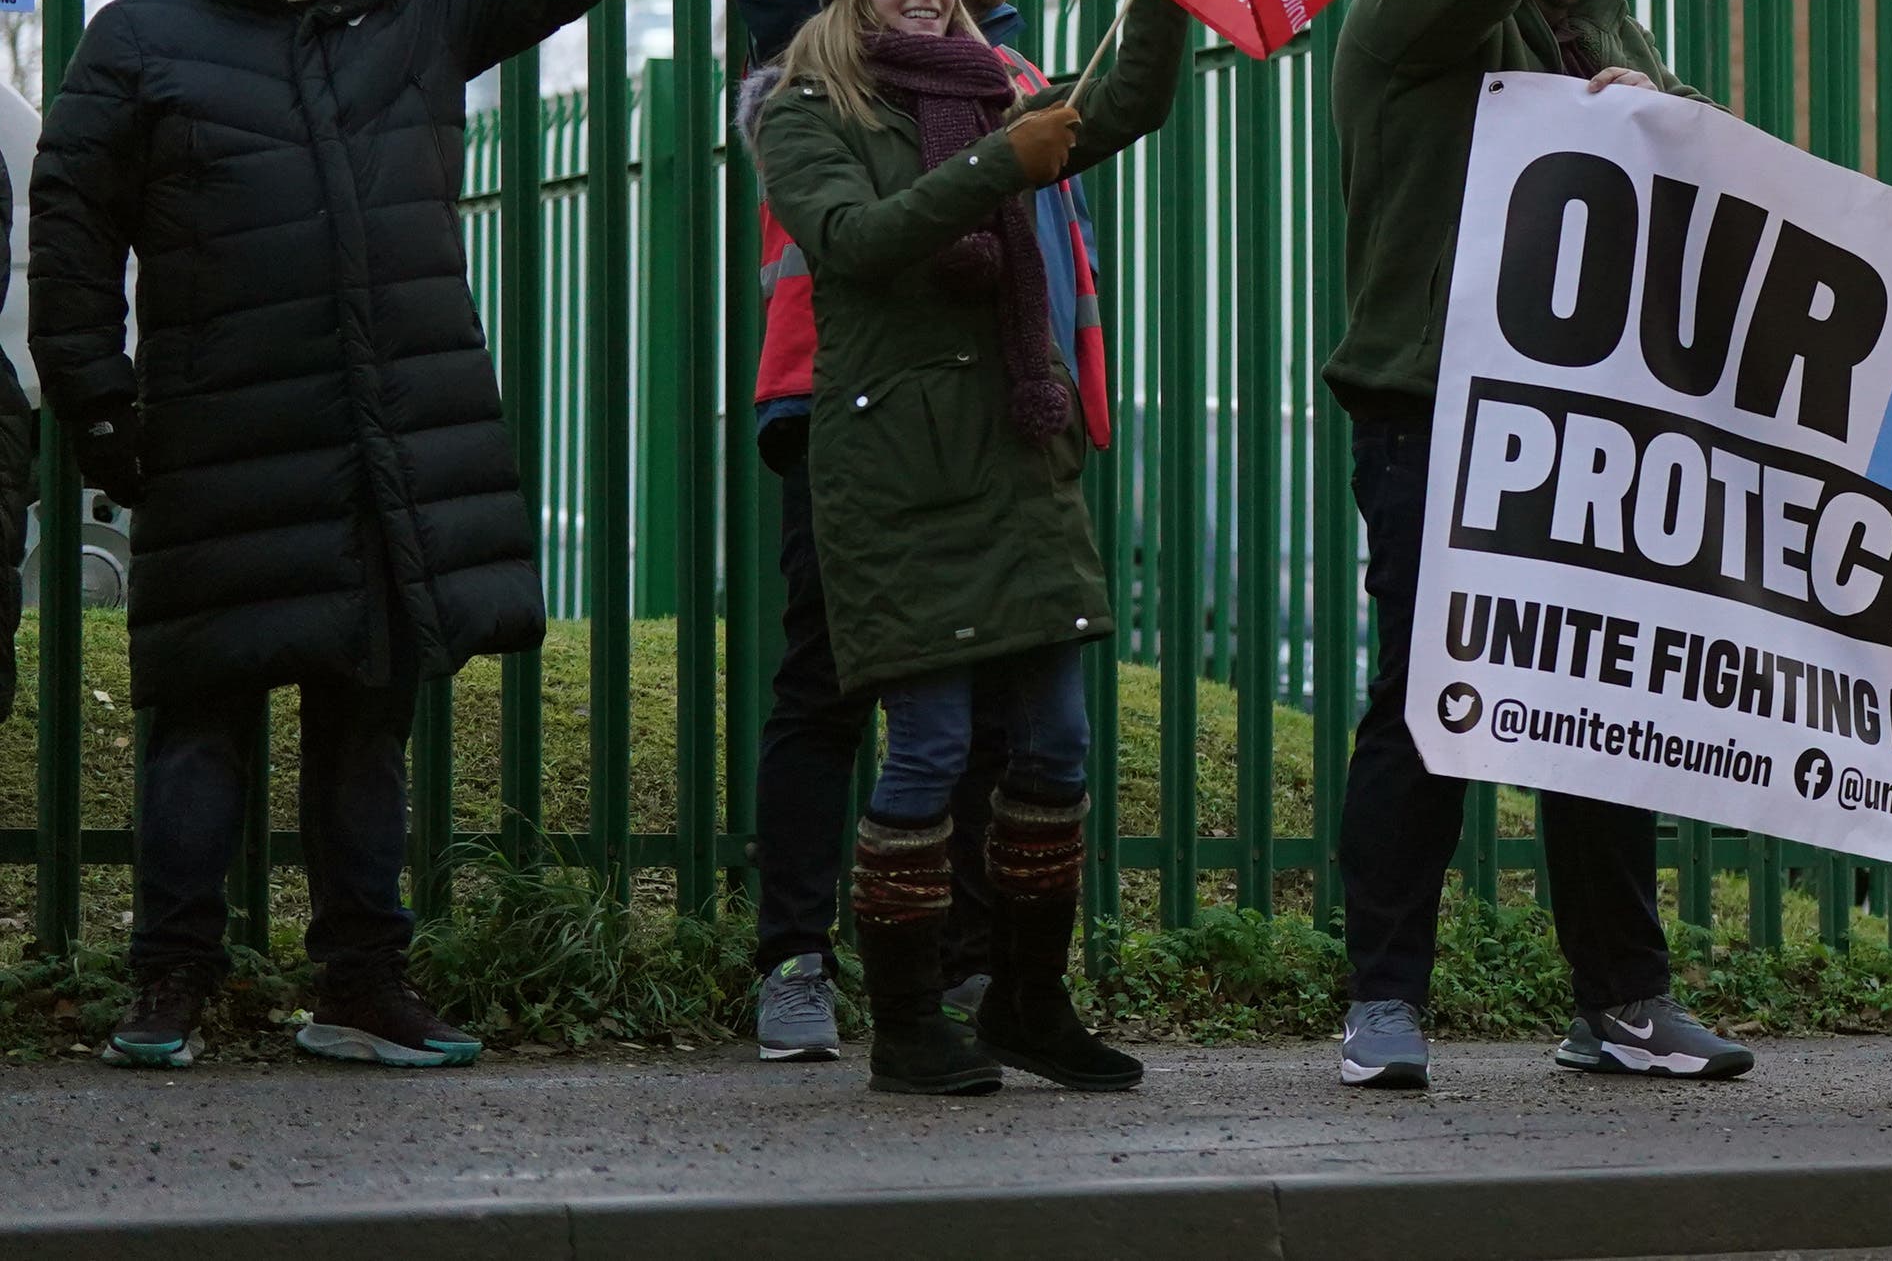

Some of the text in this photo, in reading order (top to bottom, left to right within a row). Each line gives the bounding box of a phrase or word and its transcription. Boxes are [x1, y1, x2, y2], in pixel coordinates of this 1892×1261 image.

[1496, 150, 1888, 444] OUR
[1445, 591, 1640, 688] UNITE
[1647, 626, 1881, 745] FIGHTING
[1491, 698, 1773, 788] @unitetheunion
